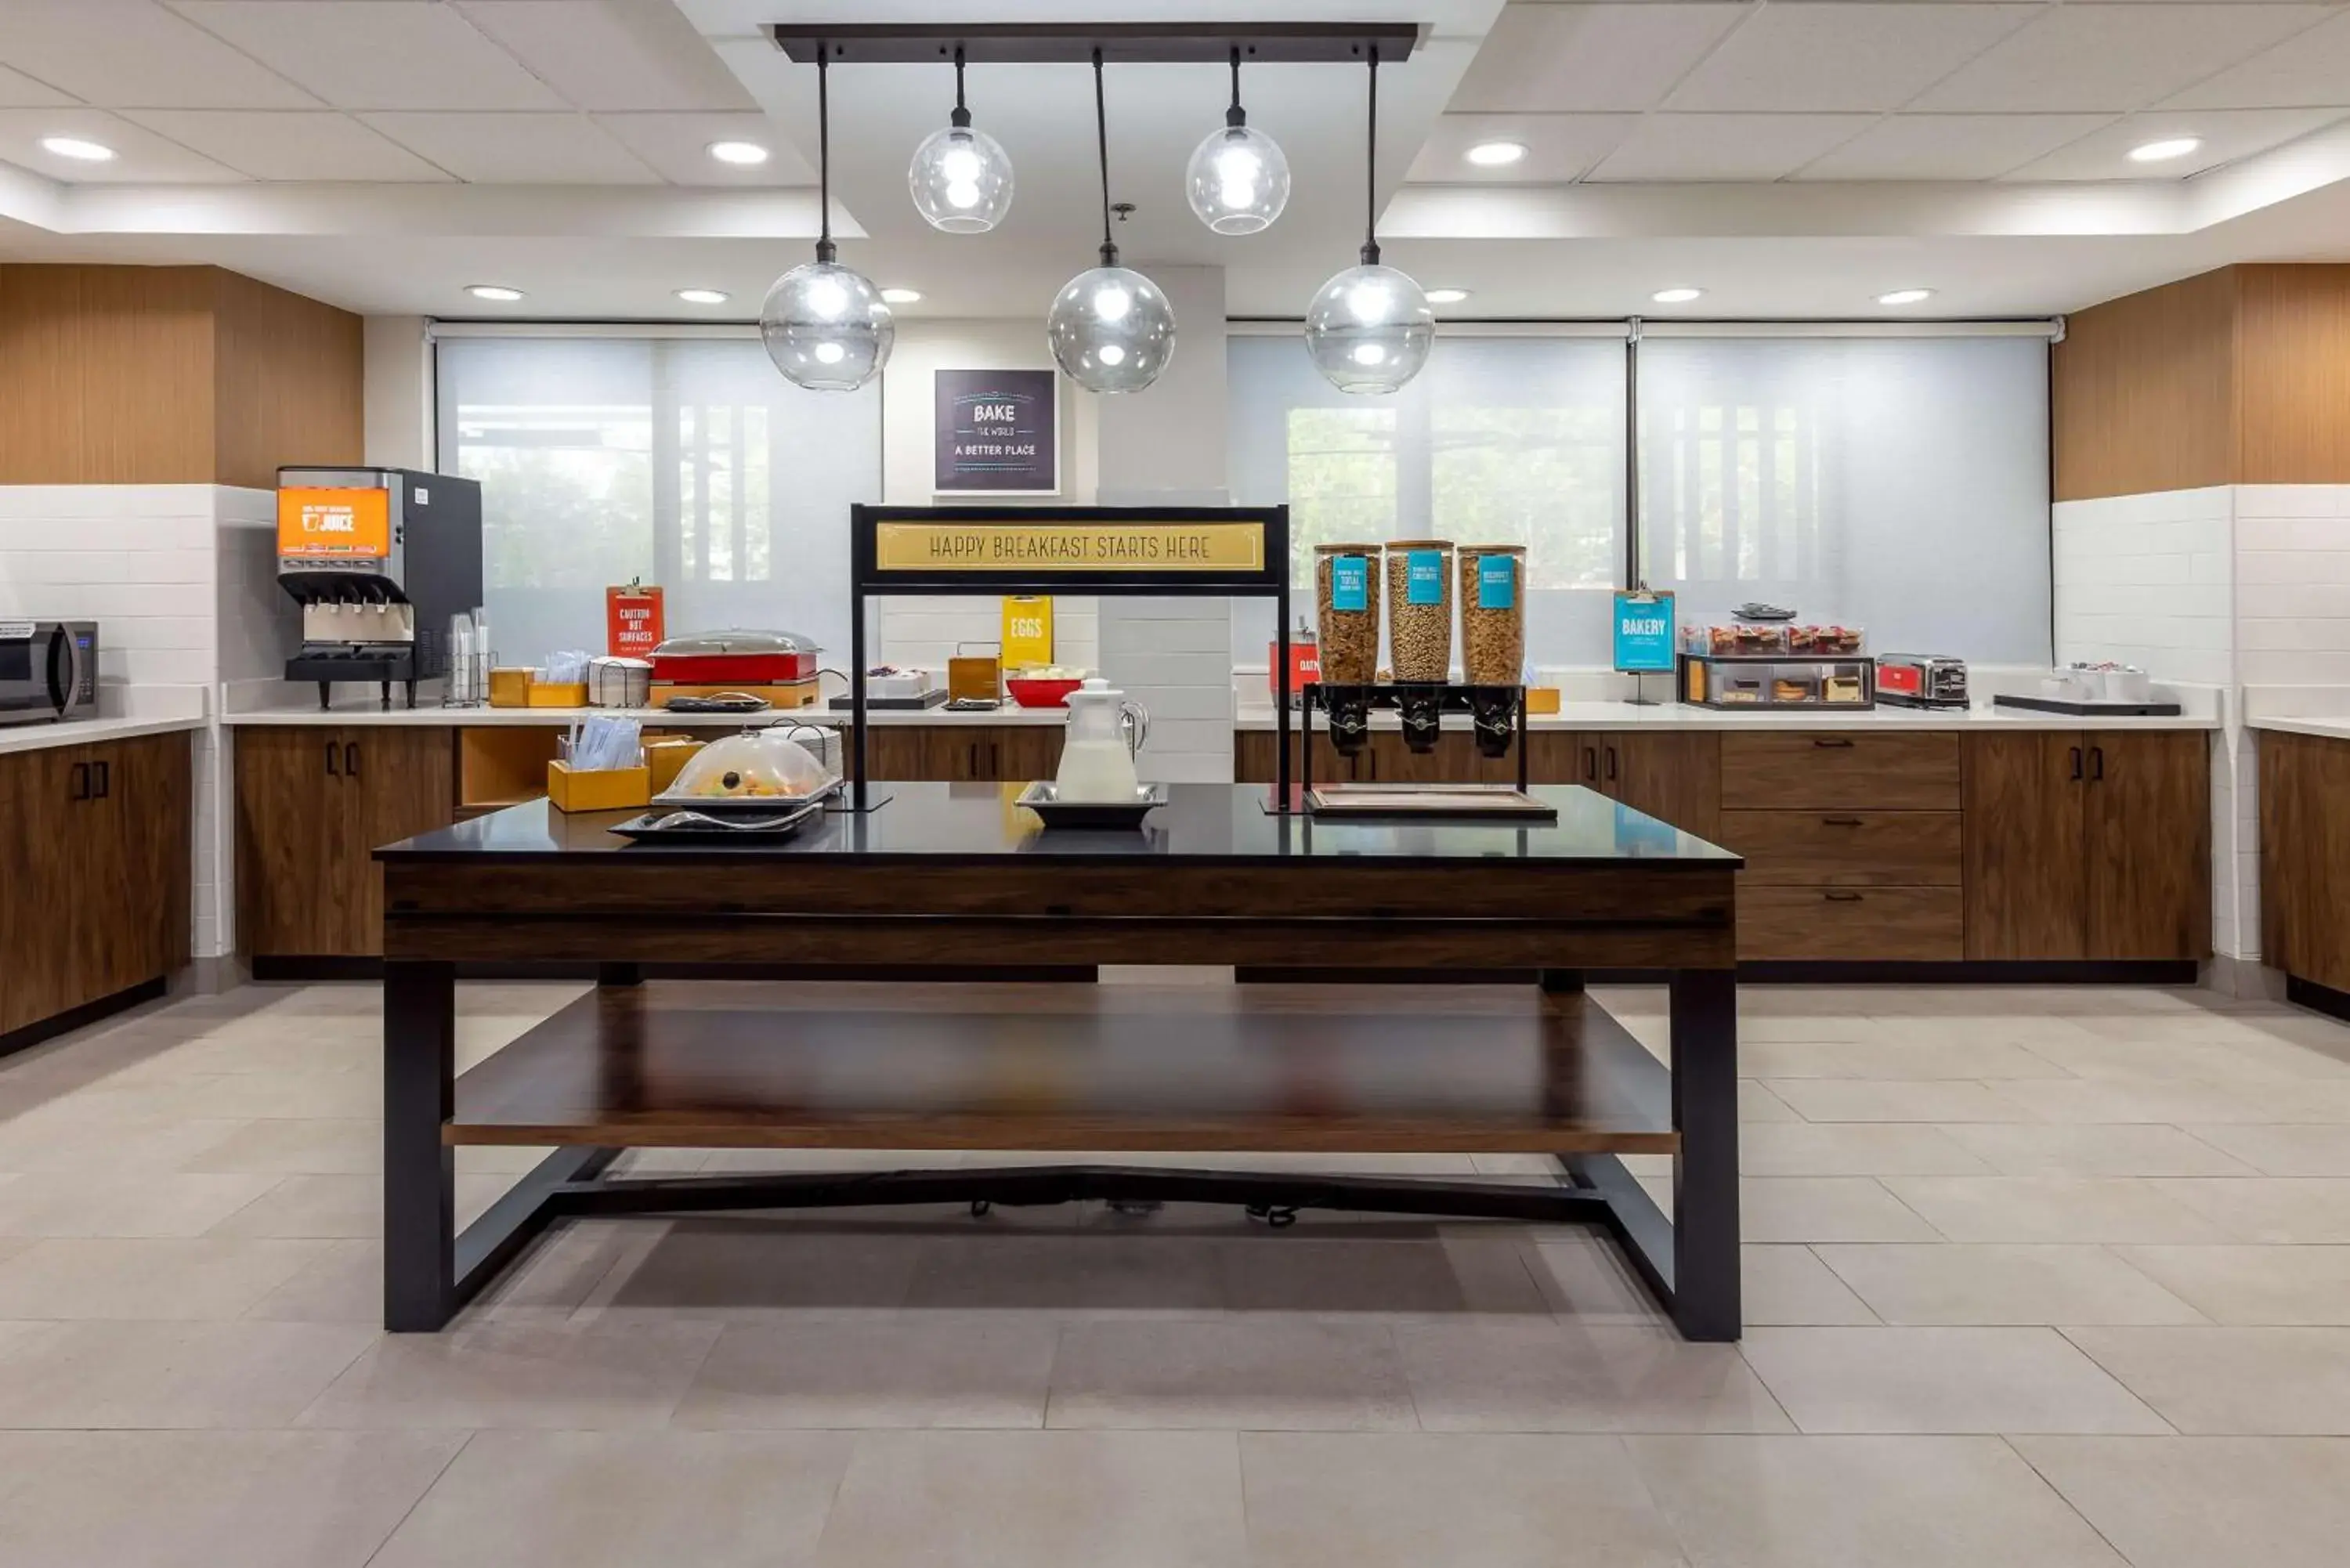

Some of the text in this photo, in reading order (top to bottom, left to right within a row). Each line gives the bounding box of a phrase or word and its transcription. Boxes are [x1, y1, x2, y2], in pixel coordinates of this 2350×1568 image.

[974, 404, 1015, 422] BAKE
[955, 444, 1036, 455] A BETTER PLACE
[320, 514, 354, 532] JUICE
[930, 536, 1211, 558] HAPPY BREAKFAST STARTS HERE
[620, 608, 649, 620] CAUTION
[629, 620, 642, 630] HOT
[1011, 617, 1042, 638] EGGS
[1622, 619, 1666, 635] BAKERY
[619, 631, 653, 642] SURFACES
